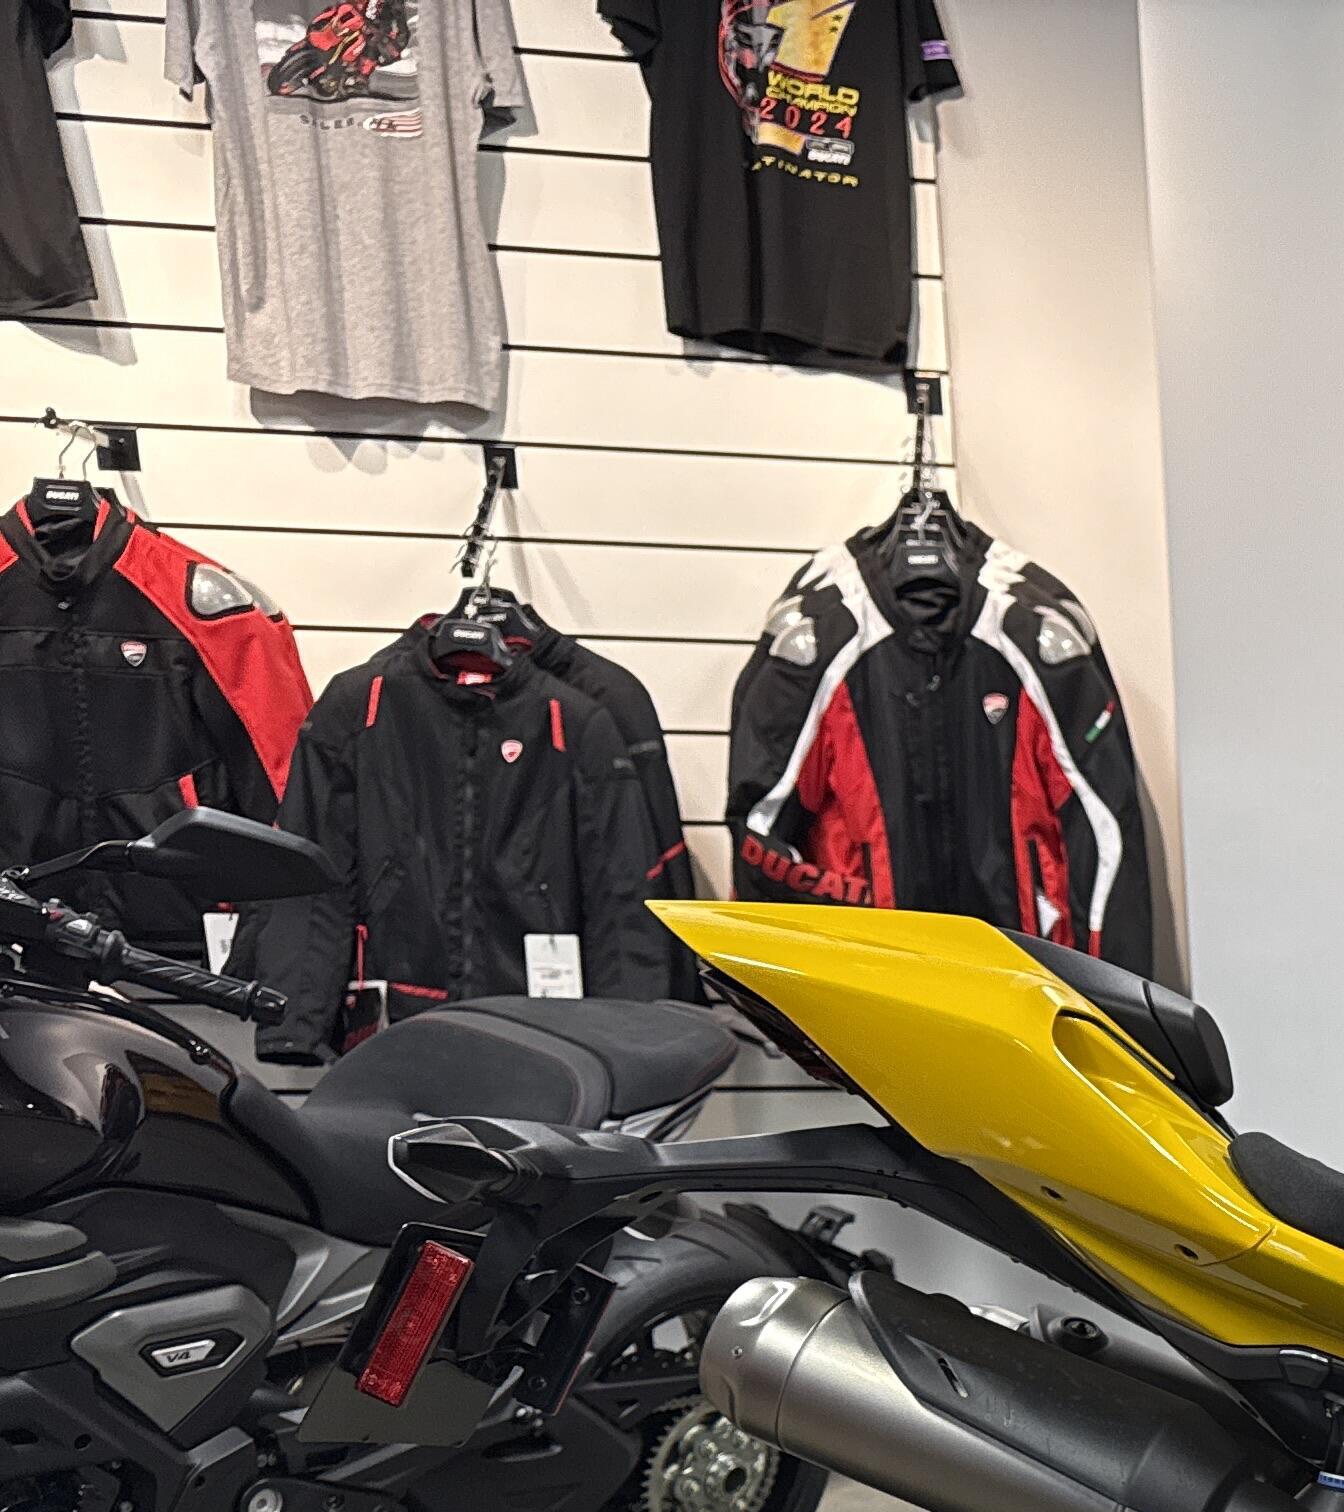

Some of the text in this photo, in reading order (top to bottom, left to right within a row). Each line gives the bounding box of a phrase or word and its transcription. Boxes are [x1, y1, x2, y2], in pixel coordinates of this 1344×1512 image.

[767, 71, 860, 105] WORLD
[760, 97, 853, 139] 2024
[166, 1351, 192, 1363] V4
